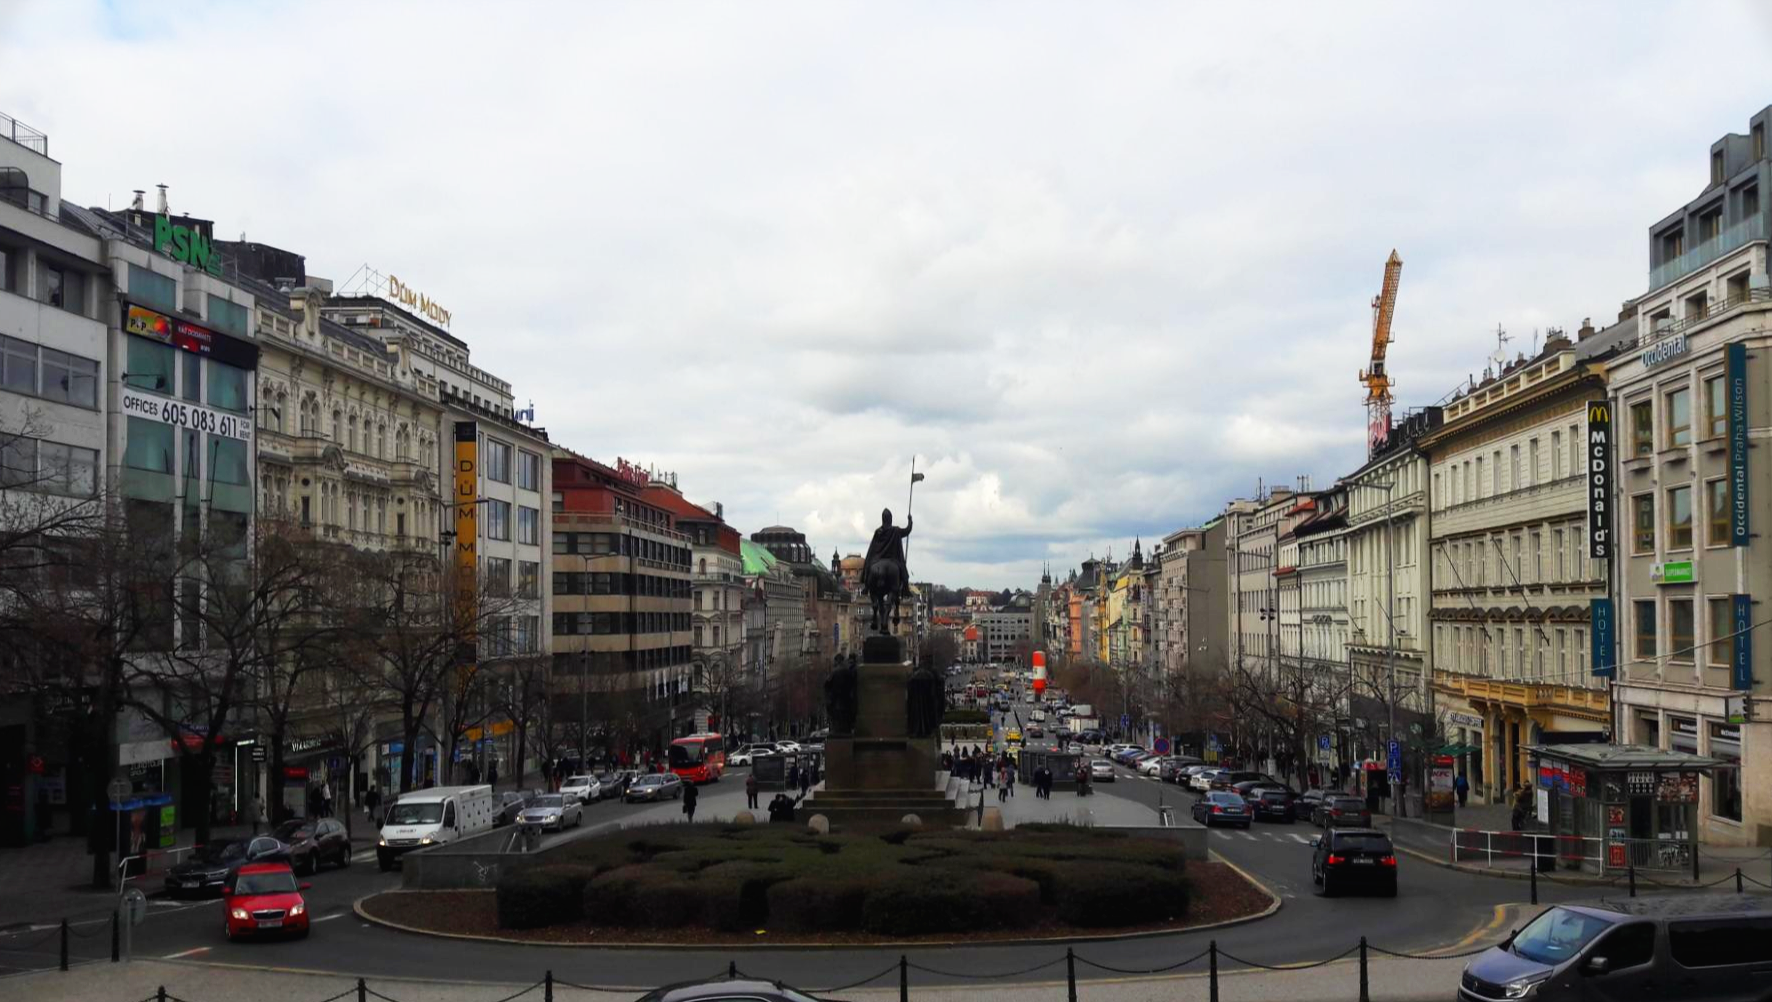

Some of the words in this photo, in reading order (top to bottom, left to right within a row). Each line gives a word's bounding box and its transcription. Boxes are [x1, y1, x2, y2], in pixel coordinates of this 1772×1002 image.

[155, 214, 210, 270] PSN
[1641, 333, 1687, 367] Occidental
[123, 396, 158, 416] OFFICES
[162, 402, 187, 426] 605
[192, 409, 215, 432] 083
[220, 416, 237, 437] 611
[240, 420, 250, 429] FOR
[1734, 378, 1745, 422] Wilson
[1735, 424, 1745, 461] Praha
[1591, 431, 1608, 556] McDonald's
[1735, 465, 1746, 536] Occidental
[1598, 607, 1606, 669] HOTEL
[1738, 604, 1746, 681] HOTEL
